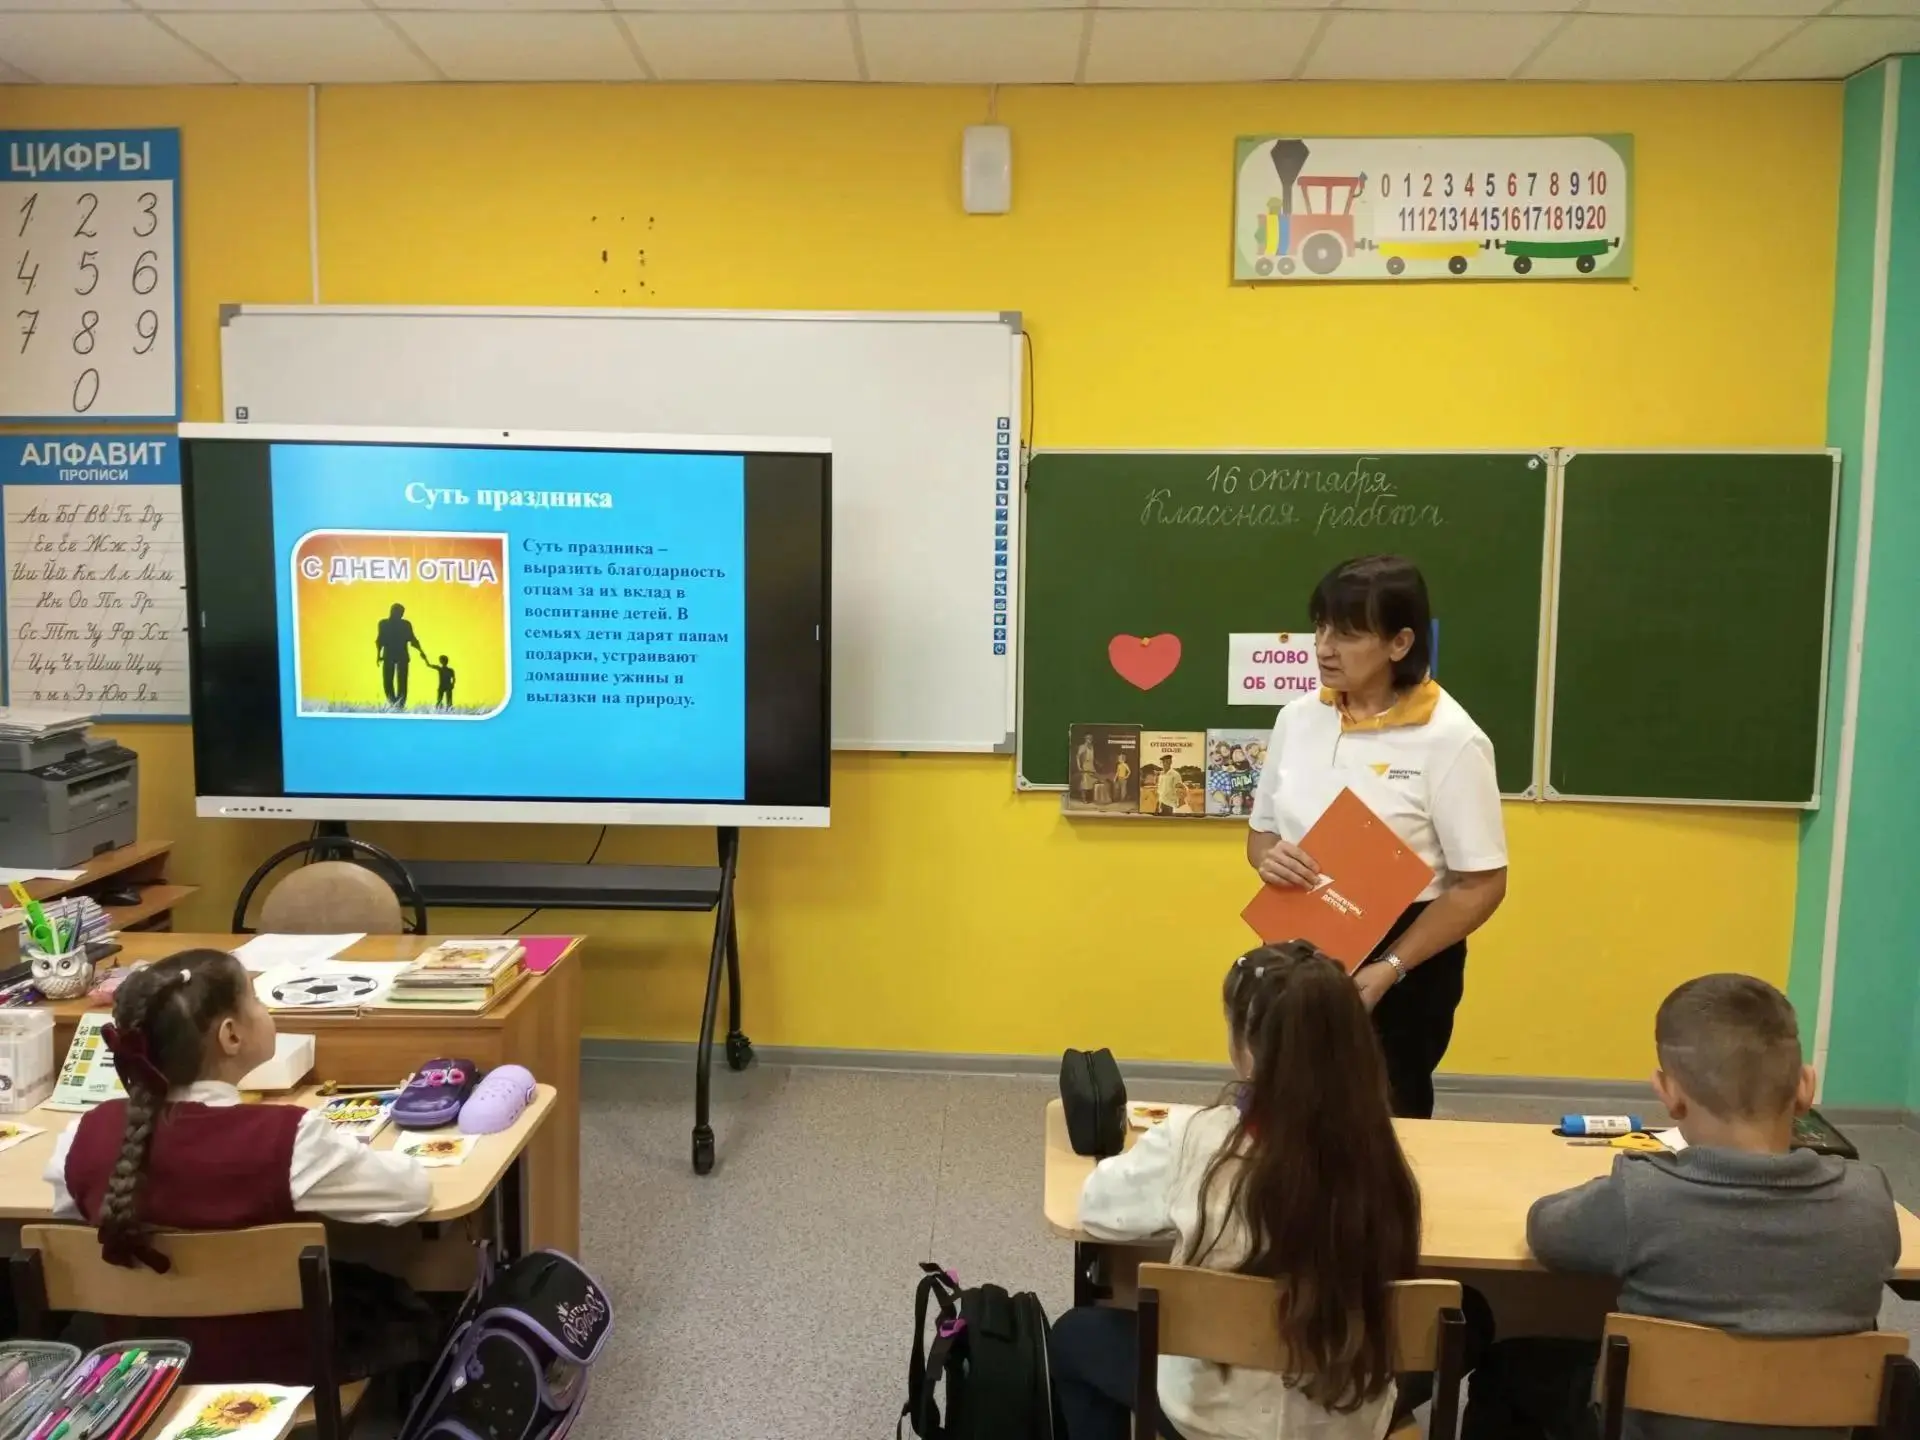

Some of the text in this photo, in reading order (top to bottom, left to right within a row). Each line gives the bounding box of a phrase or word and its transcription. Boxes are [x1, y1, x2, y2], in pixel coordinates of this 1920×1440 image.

[10, 141, 150, 178] ЦИФРЫ
[1381, 171, 1607, 197] 0 1 2 3 4 5 6 7 8 9 10
[19, 192, 158, 238] 1 2 3
[1399, 205, 1606, 231] 11 12 13 14 15 16 17 18 19 20
[16, 250, 158, 296] 4 5 6
[16, 310, 158, 355] 7 8 9
[20, 441, 167, 467] АЛФАВИТ
[59, 469, 129, 481] ПРОПИСИ
[1207, 465, 1241, 494] 16
[404, 481, 614, 511] Суть праздника
[1140, 488, 1443, 536] Классная работа
[523, 538, 562, 555] Суть
[568, 542, 653, 557] праздника
[303, 557, 497, 585] С ДНЕМ ОТЦА
[524, 562, 726, 580] выразить благодарность
[524, 585, 685, 599] отцам за их вклад в
[525, 607, 689, 621] воспитание детей. В
[524, 628, 729, 644] семьях дети дарят папам
[525, 649, 698, 665] подарки, устраивают
[1252, 650, 1308, 664] СЛОВО
[525, 670, 684, 686] домашние ужины и
[1243, 676, 1316, 692] ОБ ОТЦЕ
[527, 692, 695, 708] вылазки на природу.
